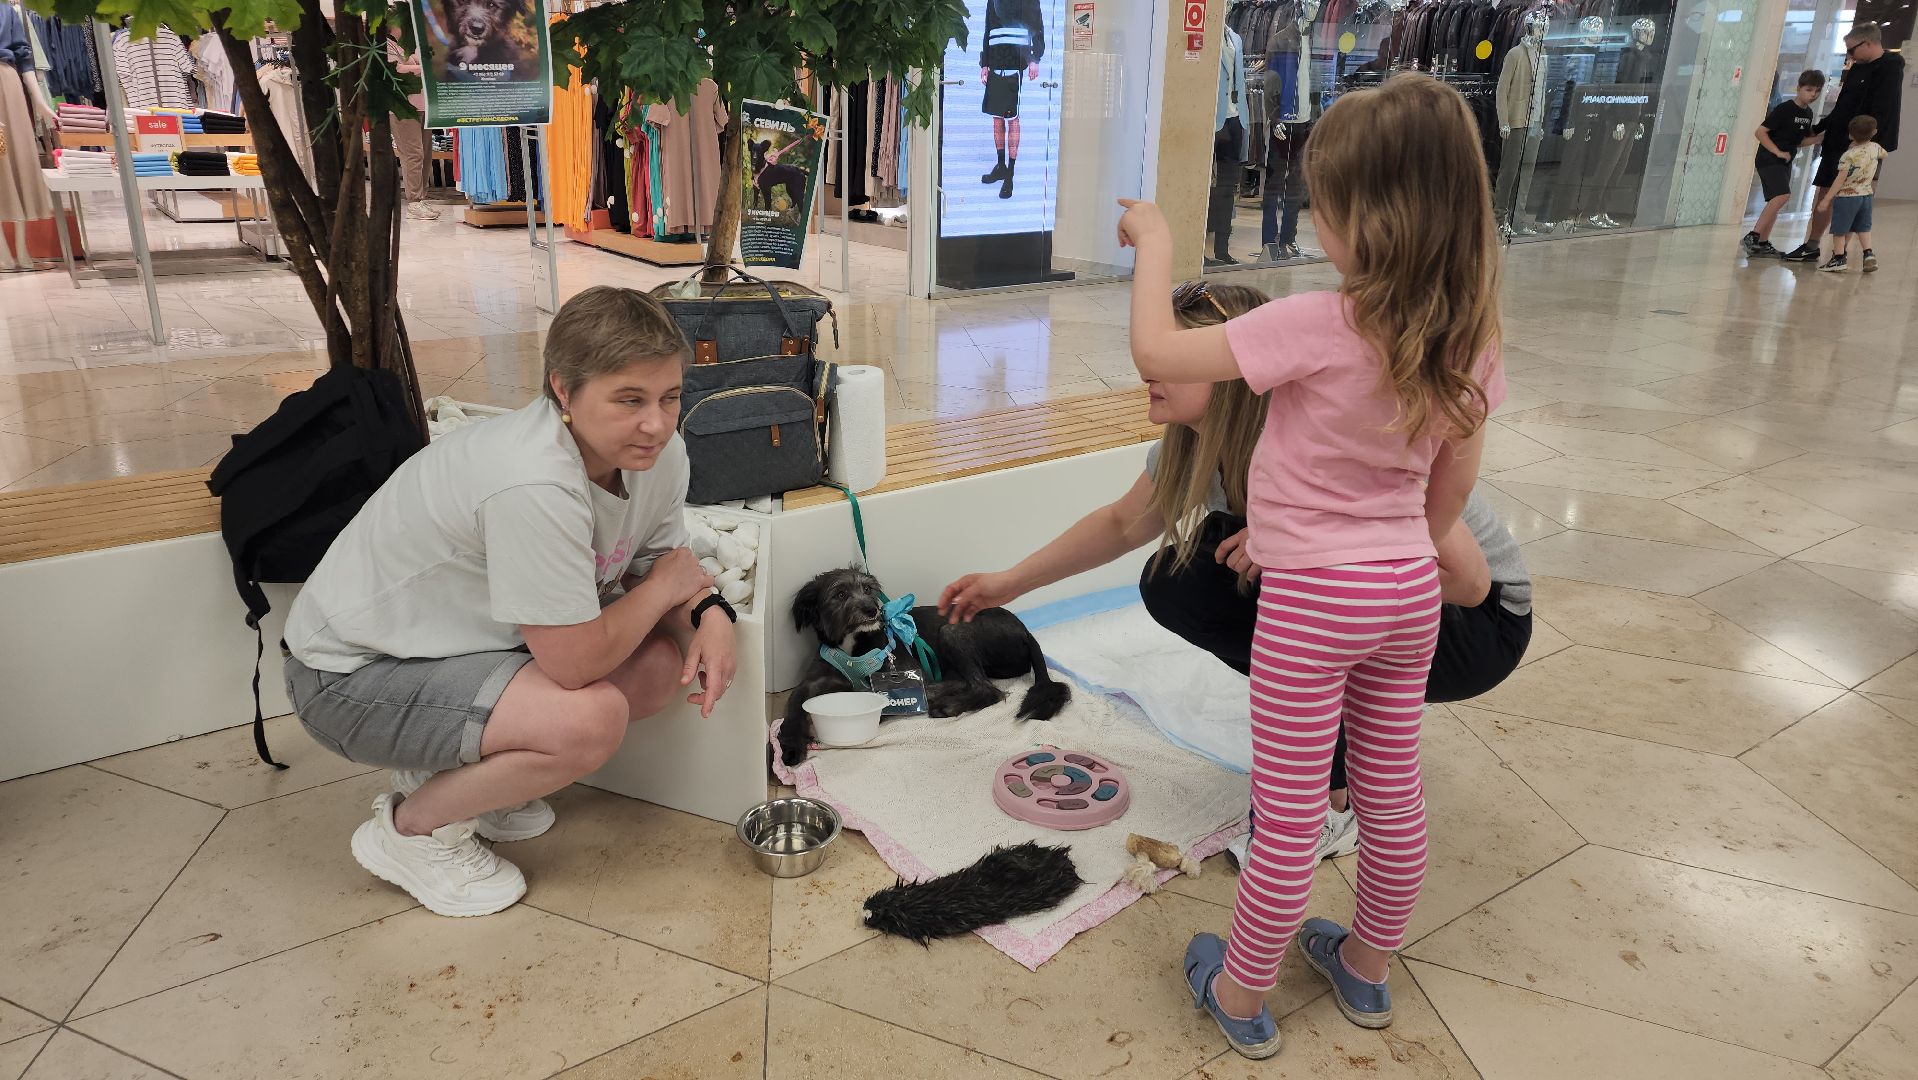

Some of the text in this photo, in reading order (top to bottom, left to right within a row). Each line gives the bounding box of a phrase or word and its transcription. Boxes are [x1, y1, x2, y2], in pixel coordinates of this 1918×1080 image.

[468, 63, 515, 71] месяцев
[148, 120, 167, 129] sale
[753, 117, 796, 133] СЕВИЛЬ
[889, 697, 918, 706] ОНЕР
